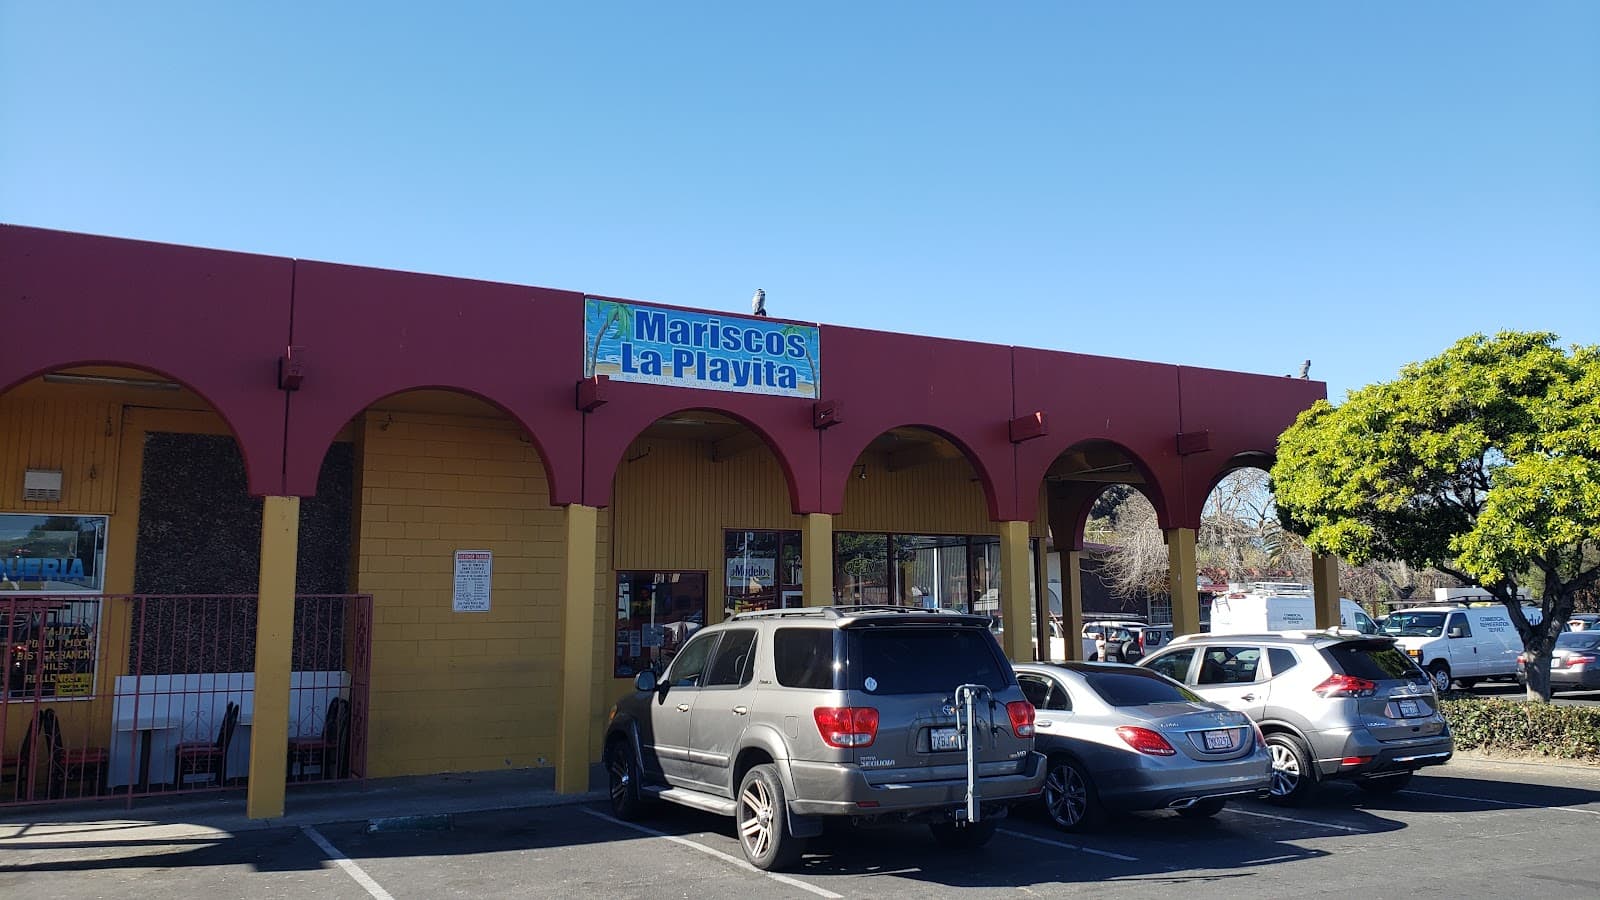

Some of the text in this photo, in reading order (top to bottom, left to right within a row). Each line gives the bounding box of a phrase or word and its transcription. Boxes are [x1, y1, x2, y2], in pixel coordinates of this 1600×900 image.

[634, 309, 807, 358] Mariscos
[620, 342, 797, 389] La Playita
[0, 557, 85, 581] UERIA
[735, 565, 766, 577] Modelo
[861, 759, 896, 767] SEQUOIA
